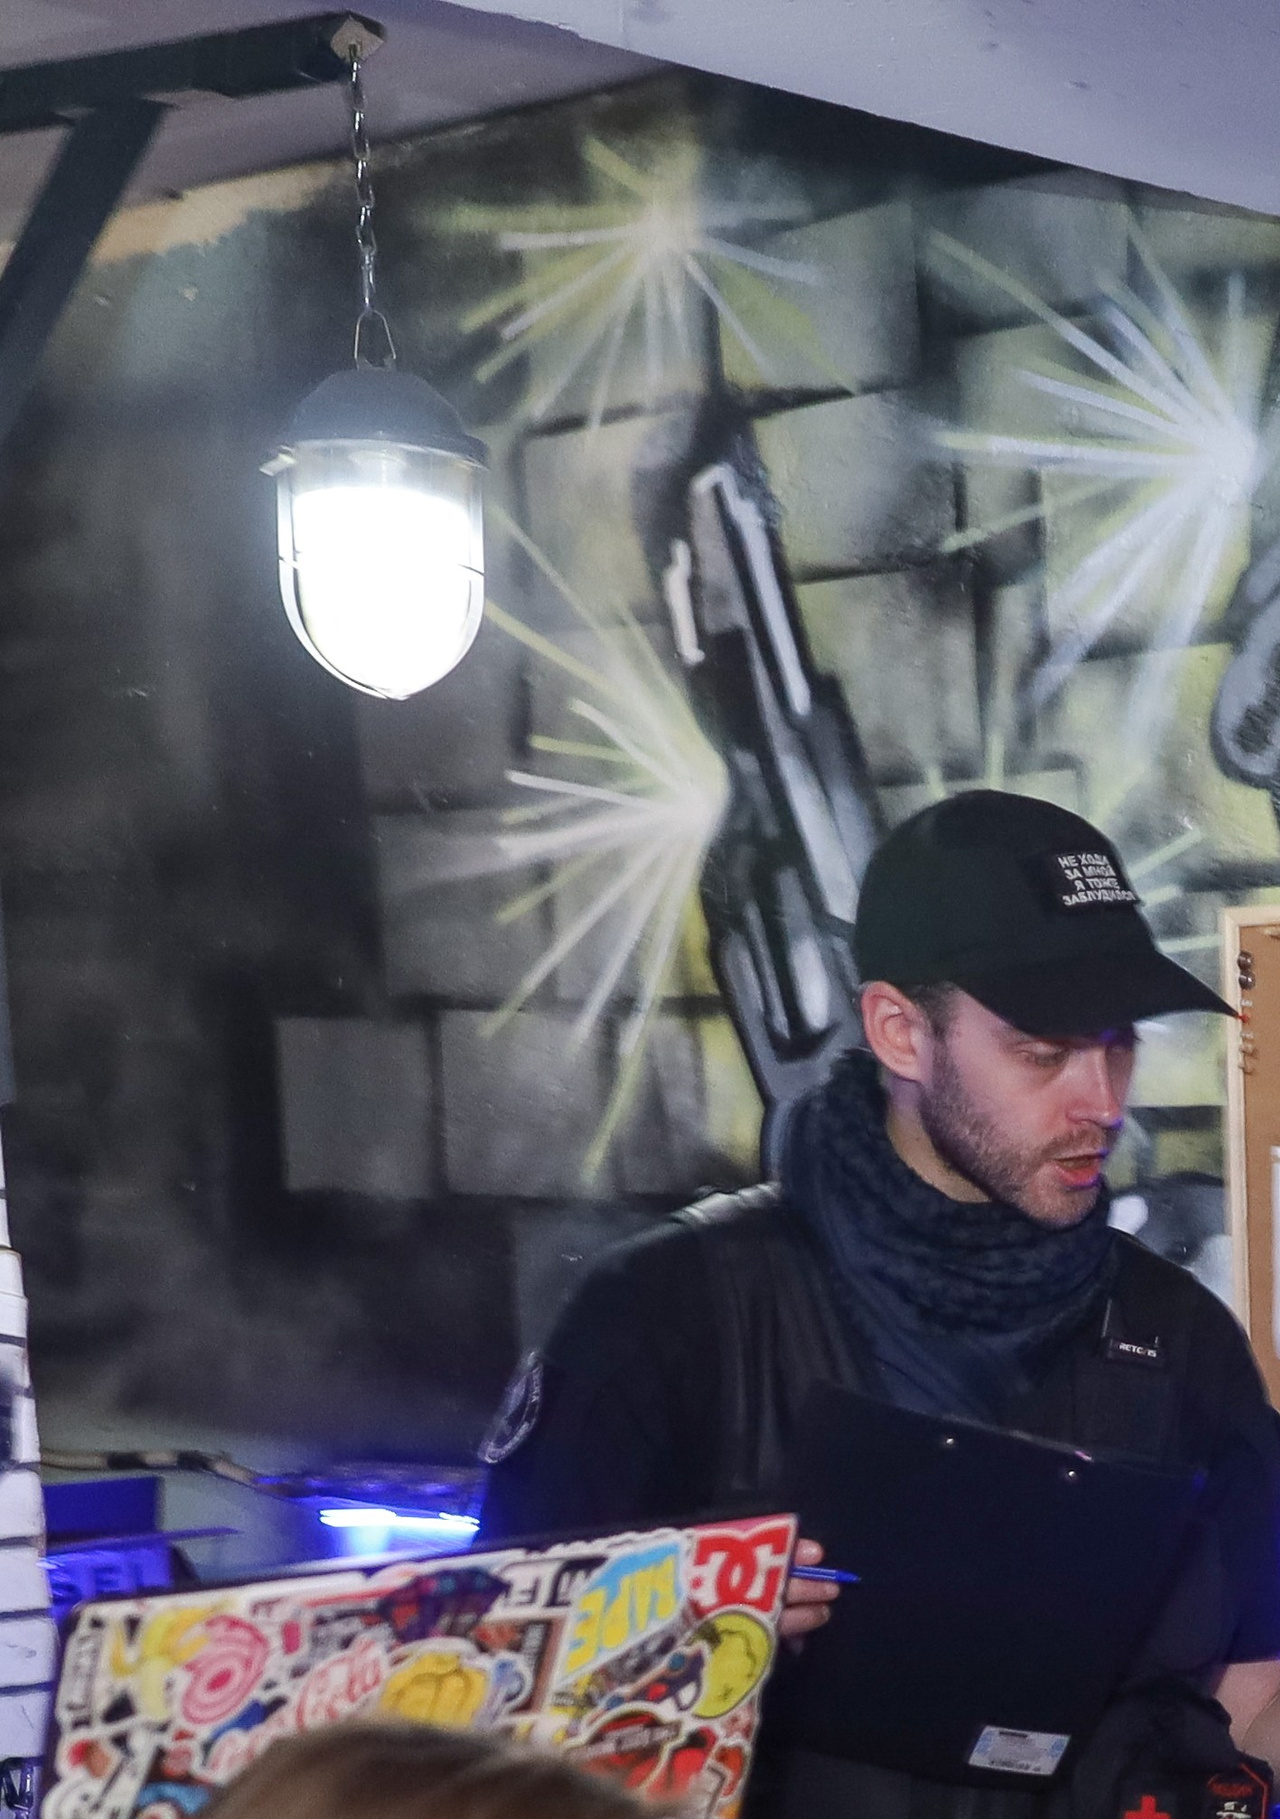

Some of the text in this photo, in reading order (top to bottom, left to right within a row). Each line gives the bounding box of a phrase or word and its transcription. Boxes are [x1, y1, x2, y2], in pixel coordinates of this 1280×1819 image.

[1057, 855, 1079, 869] НЕ
[1064, 868, 1083, 880] ЗА
[1073, 877, 1120, 891] Я ТОЖЕ
